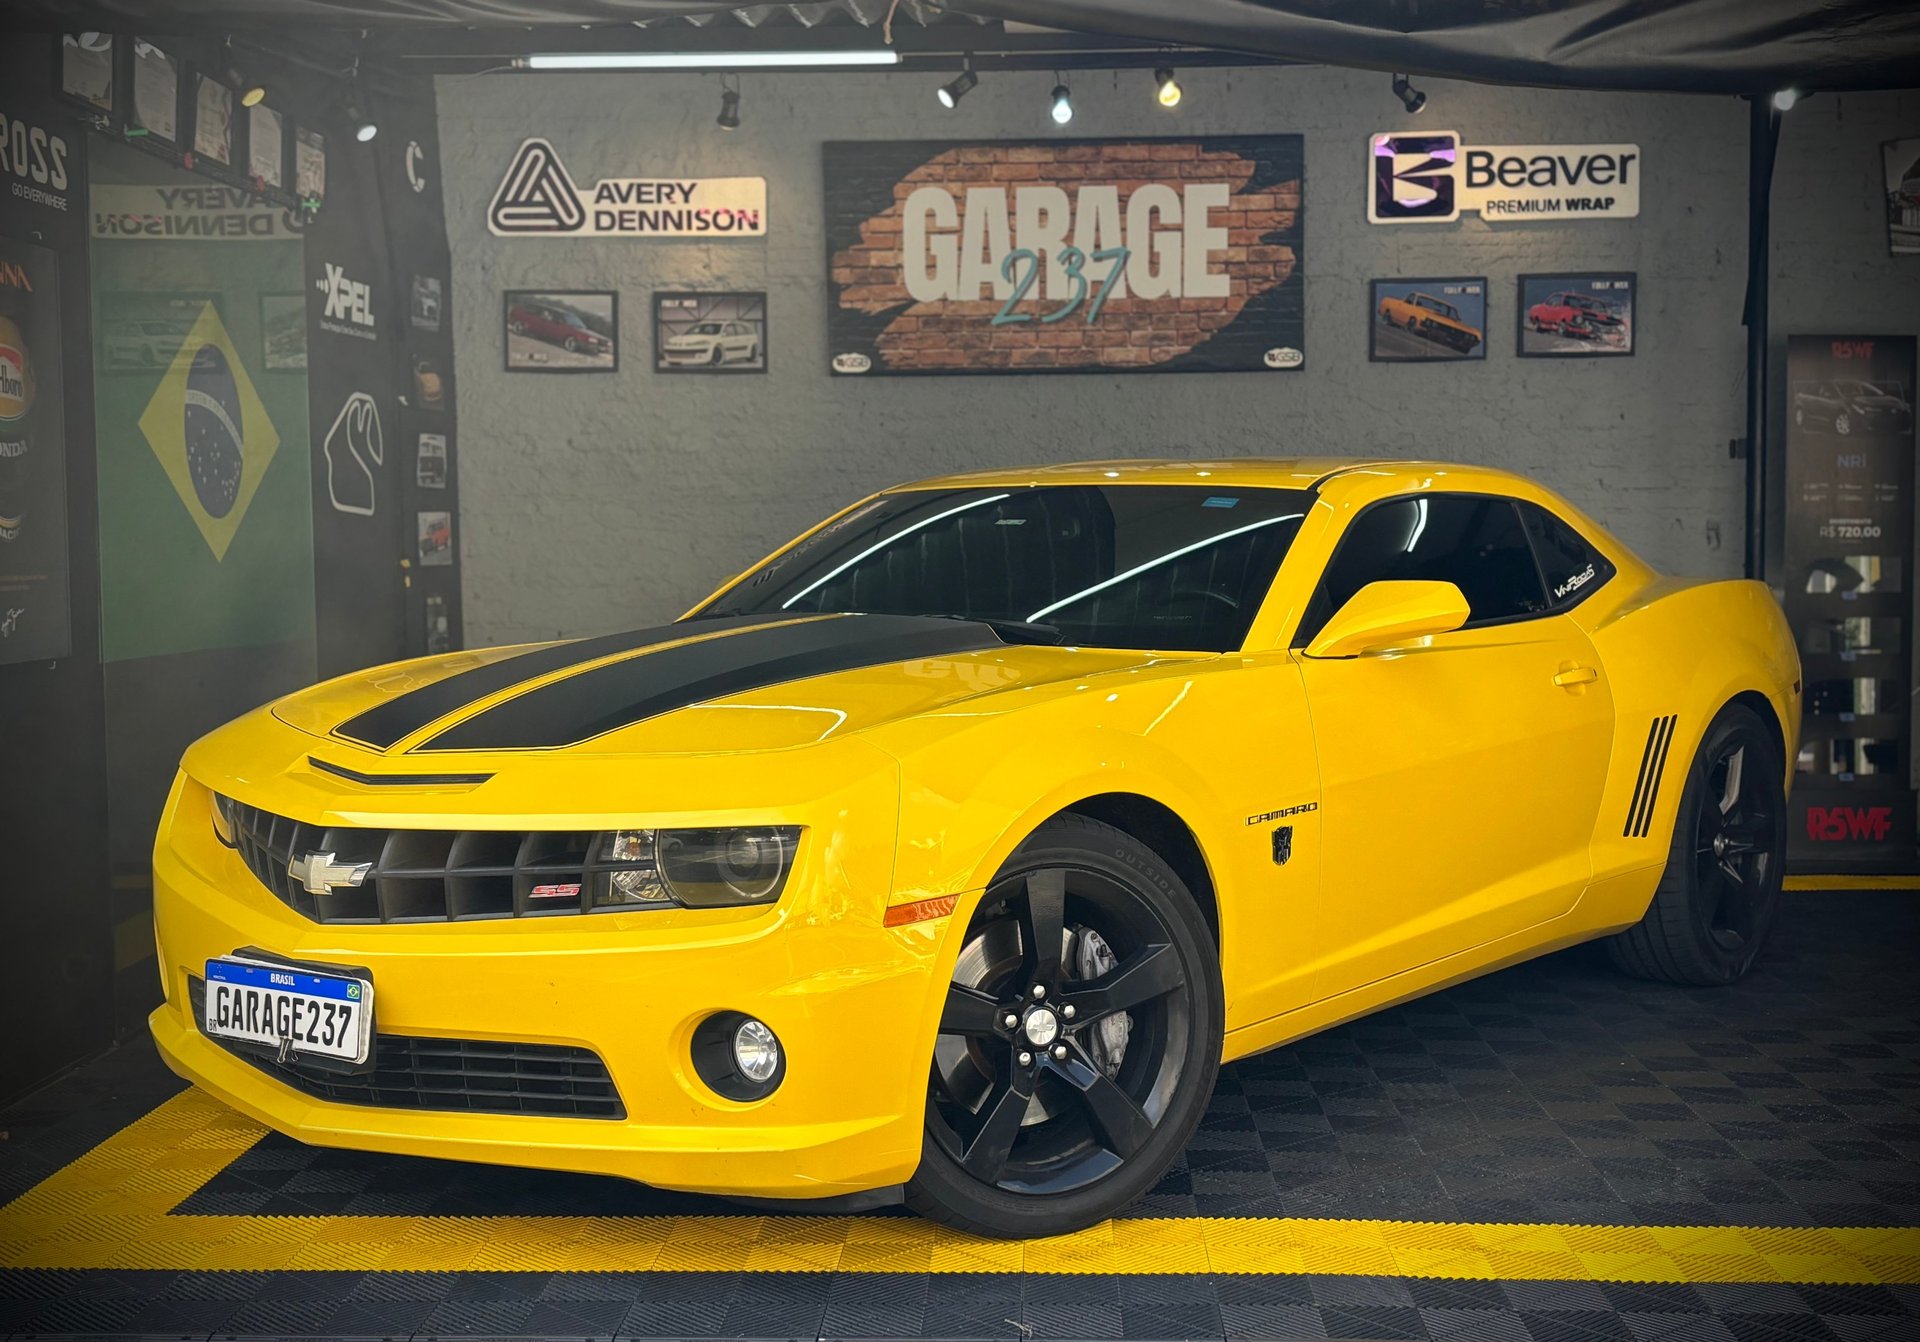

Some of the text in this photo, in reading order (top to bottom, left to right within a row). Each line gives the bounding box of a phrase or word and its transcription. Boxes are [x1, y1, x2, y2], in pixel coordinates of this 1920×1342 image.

[1466, 151, 1636, 188] Beaver
[12, 182, 68, 211] GO EVERYWHERE
[594, 183, 697, 204] AVERY
[1487, 197, 1615, 214] PREMIUM WRAP
[594, 209, 759, 231] DENNISON
[902, 183, 1230, 302] GARAGE
[324, 262, 374, 327] XPEL
[991, 246, 1131, 325] 237
[0, 440, 28, 457] NDA
[1245, 802, 1318, 826] CAMARO
[1806, 806, 1892, 841] RSWF
[1115, 849, 1176, 898] OUTSIDE
[528, 883, 582, 898] SS
[270, 973, 295, 986] BRASIL
[208, 1017, 218, 1031] BR
[216, 986, 352, 1048] GARAGE237
